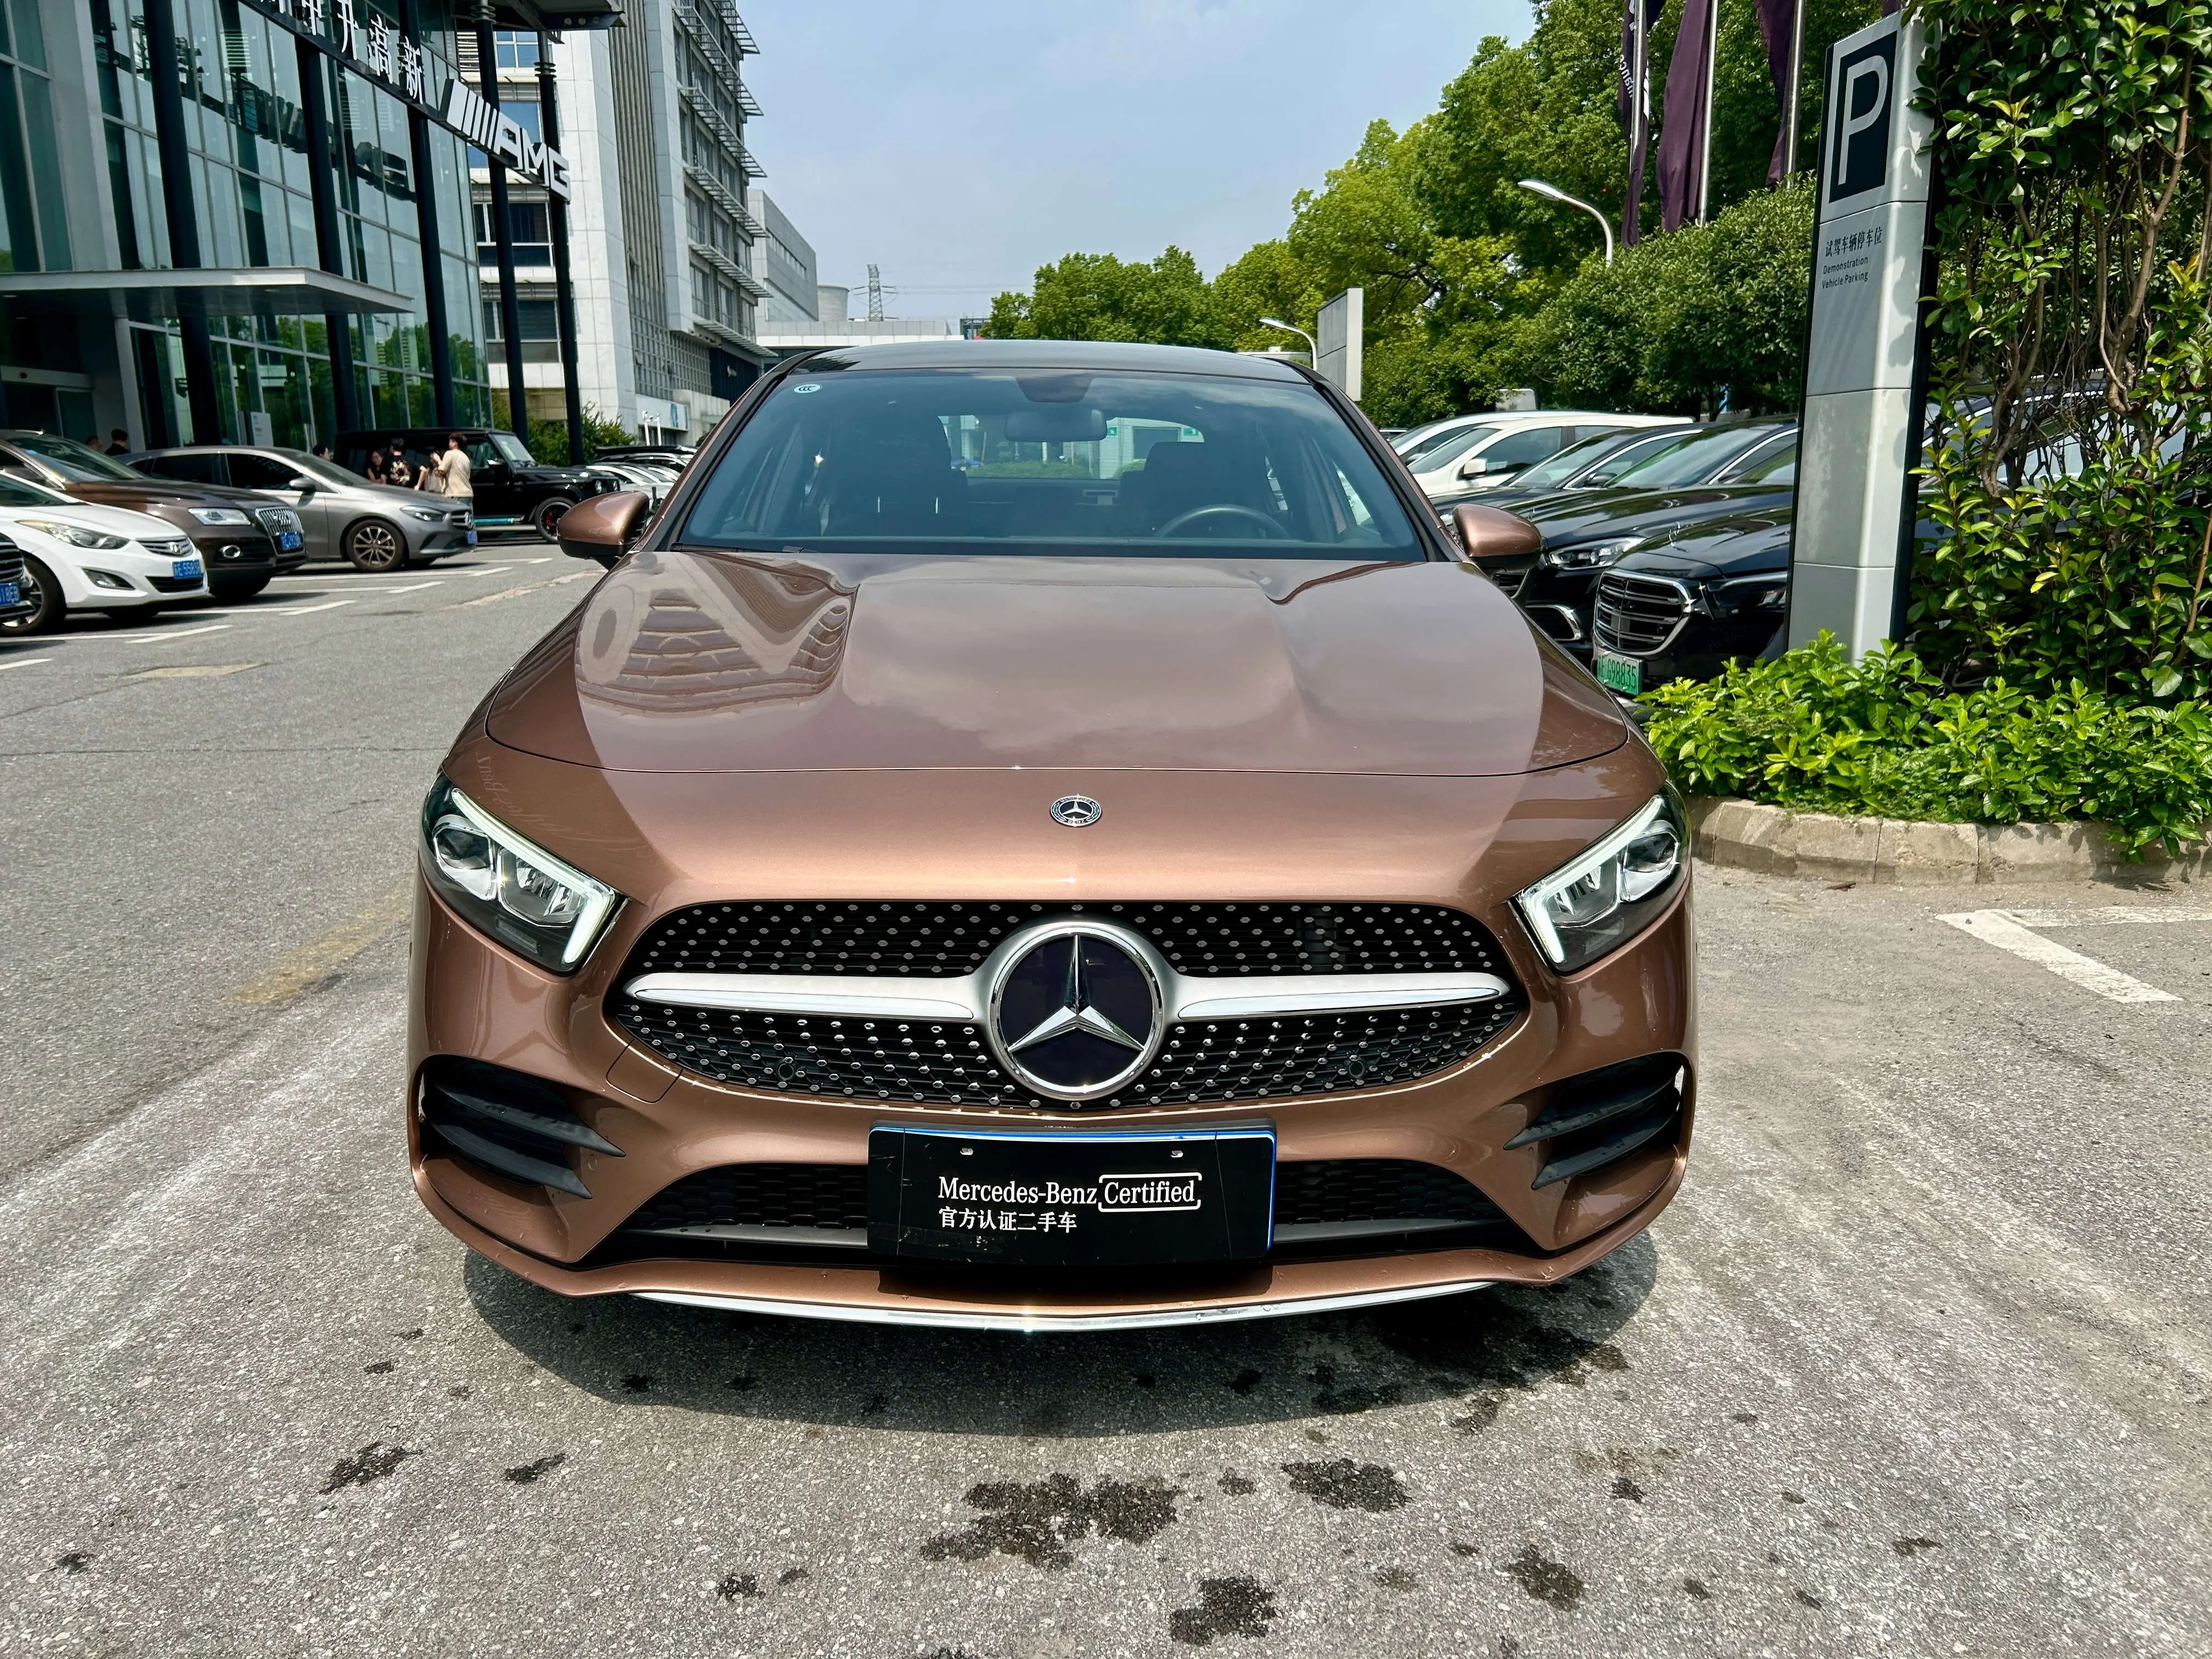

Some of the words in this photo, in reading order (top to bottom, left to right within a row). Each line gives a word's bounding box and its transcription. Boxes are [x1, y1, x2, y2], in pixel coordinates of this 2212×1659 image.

[1838, 54, 1888, 186] P
[1825, 226, 1882, 257] 试驾车辆停车位
[1823, 257, 1868, 274] Demonstration
[1822, 276, 1843, 289] Vehicle
[1844, 272, 1869, 284] Parking
[938, 1176, 1098, 1205] Mercedes-Benz
[1104, 1180, 1195, 1204] Certified
[939, 1206, 1077, 1234] 官方认证二手车
